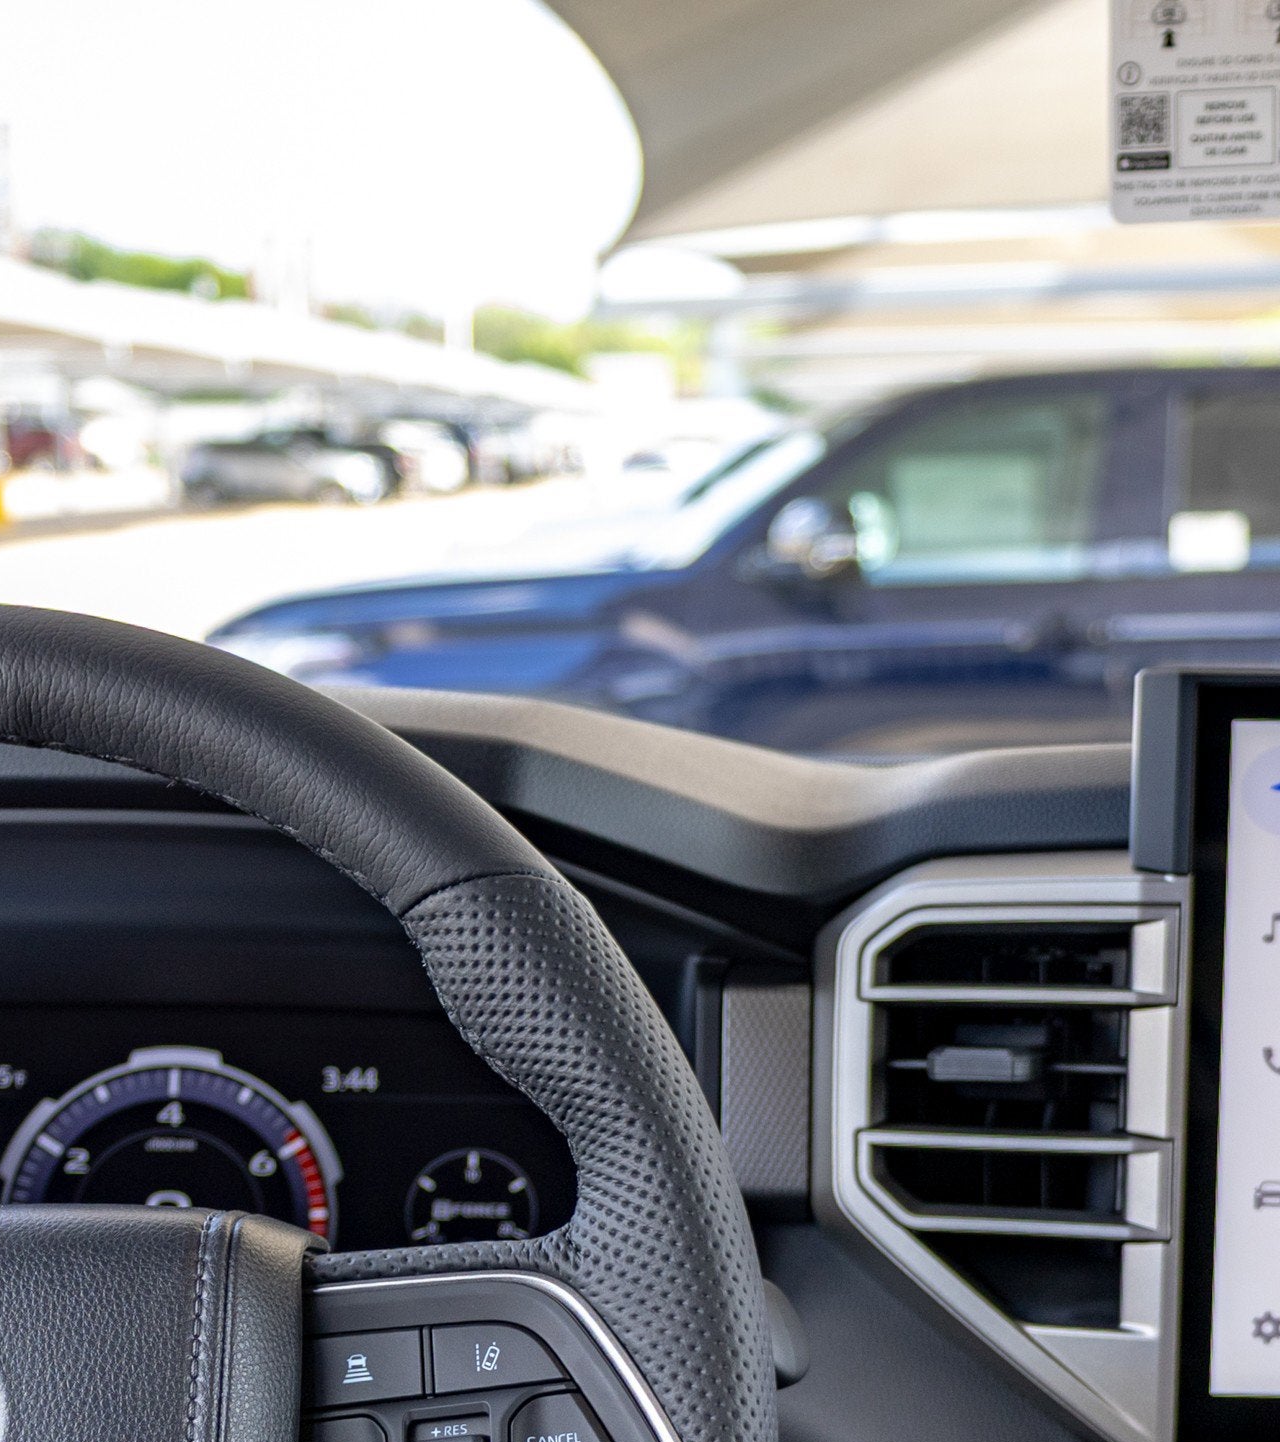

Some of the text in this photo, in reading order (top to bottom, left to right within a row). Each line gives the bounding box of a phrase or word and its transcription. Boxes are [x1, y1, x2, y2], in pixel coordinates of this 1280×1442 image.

[322, 1066, 379, 1093] 3:44
[156, 1101, 185, 1127] 4
[63, 1148, 91, 1174] 2
[248, 1149, 278, 1178] 6
